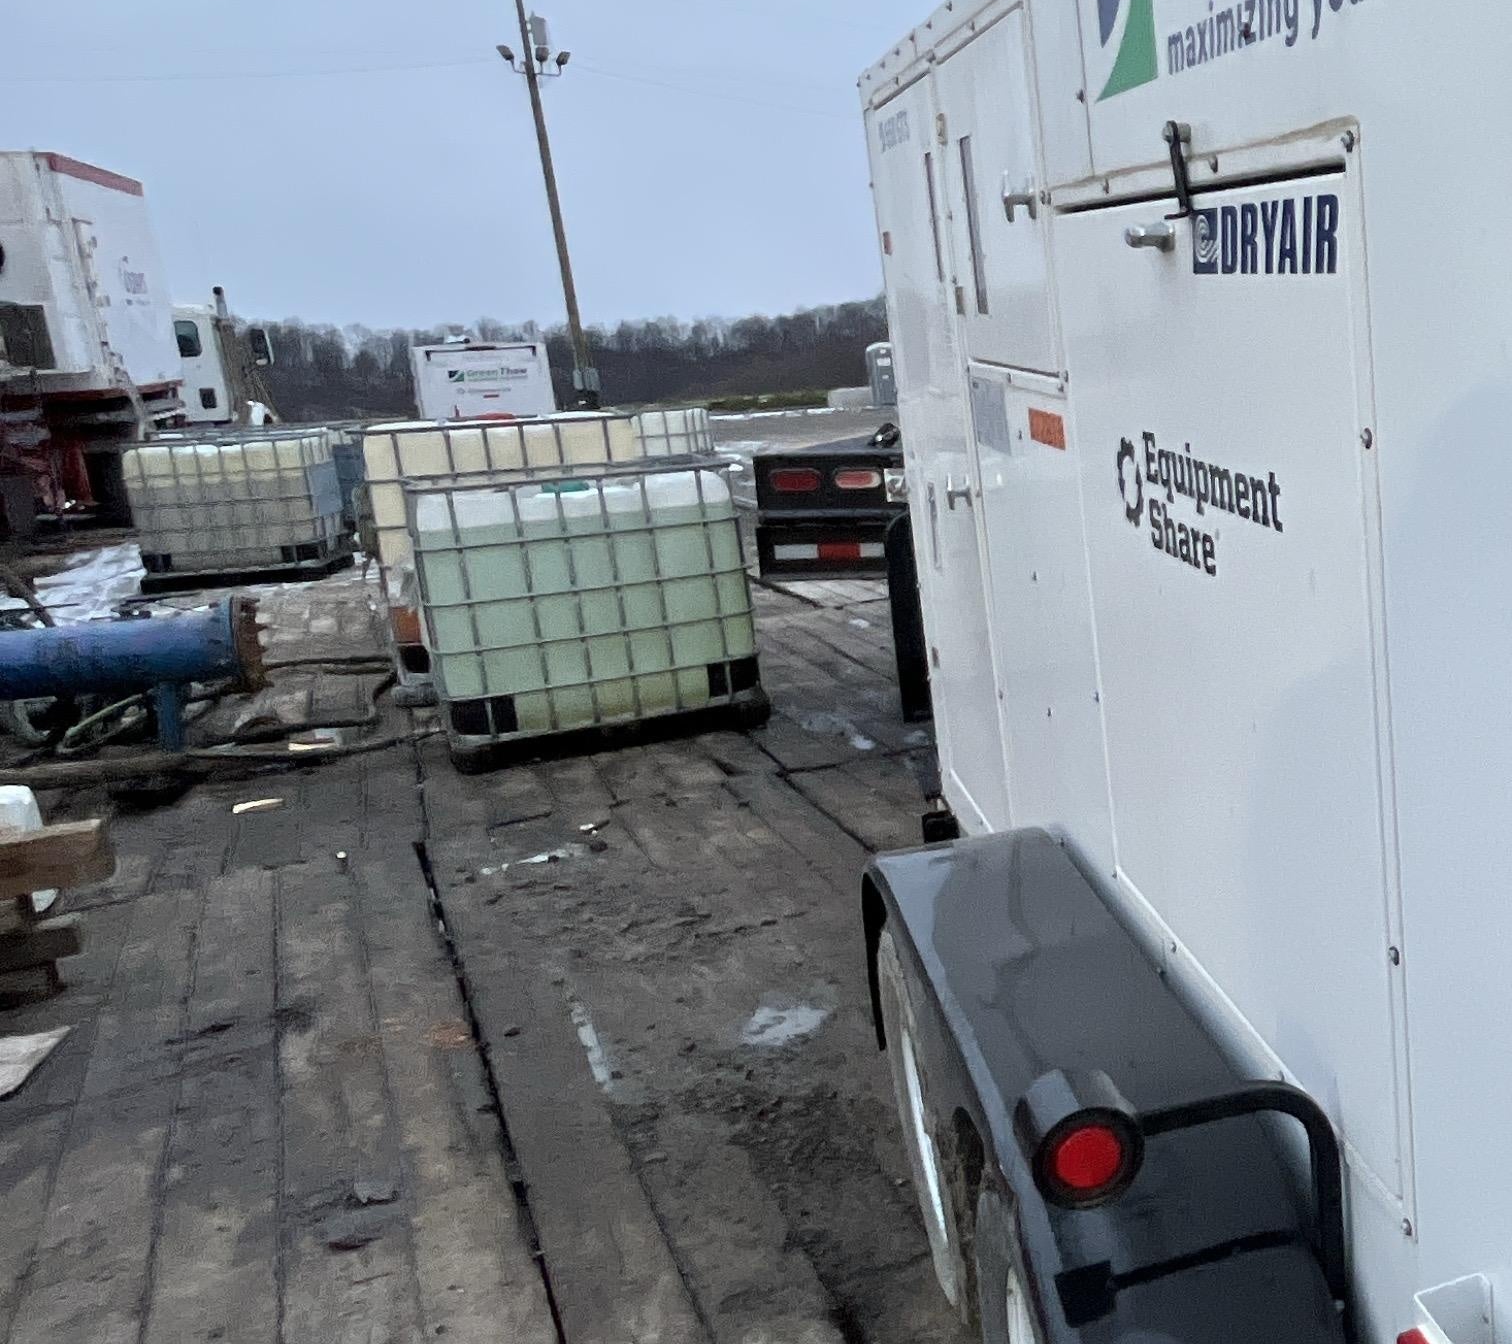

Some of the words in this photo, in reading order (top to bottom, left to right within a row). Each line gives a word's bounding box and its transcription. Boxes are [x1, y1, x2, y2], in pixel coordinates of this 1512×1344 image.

[1220, 193, 1339, 275] DRYAIR
[1142, 430, 1284, 533] Equipment
[1148, 497, 1218, 577] Share
